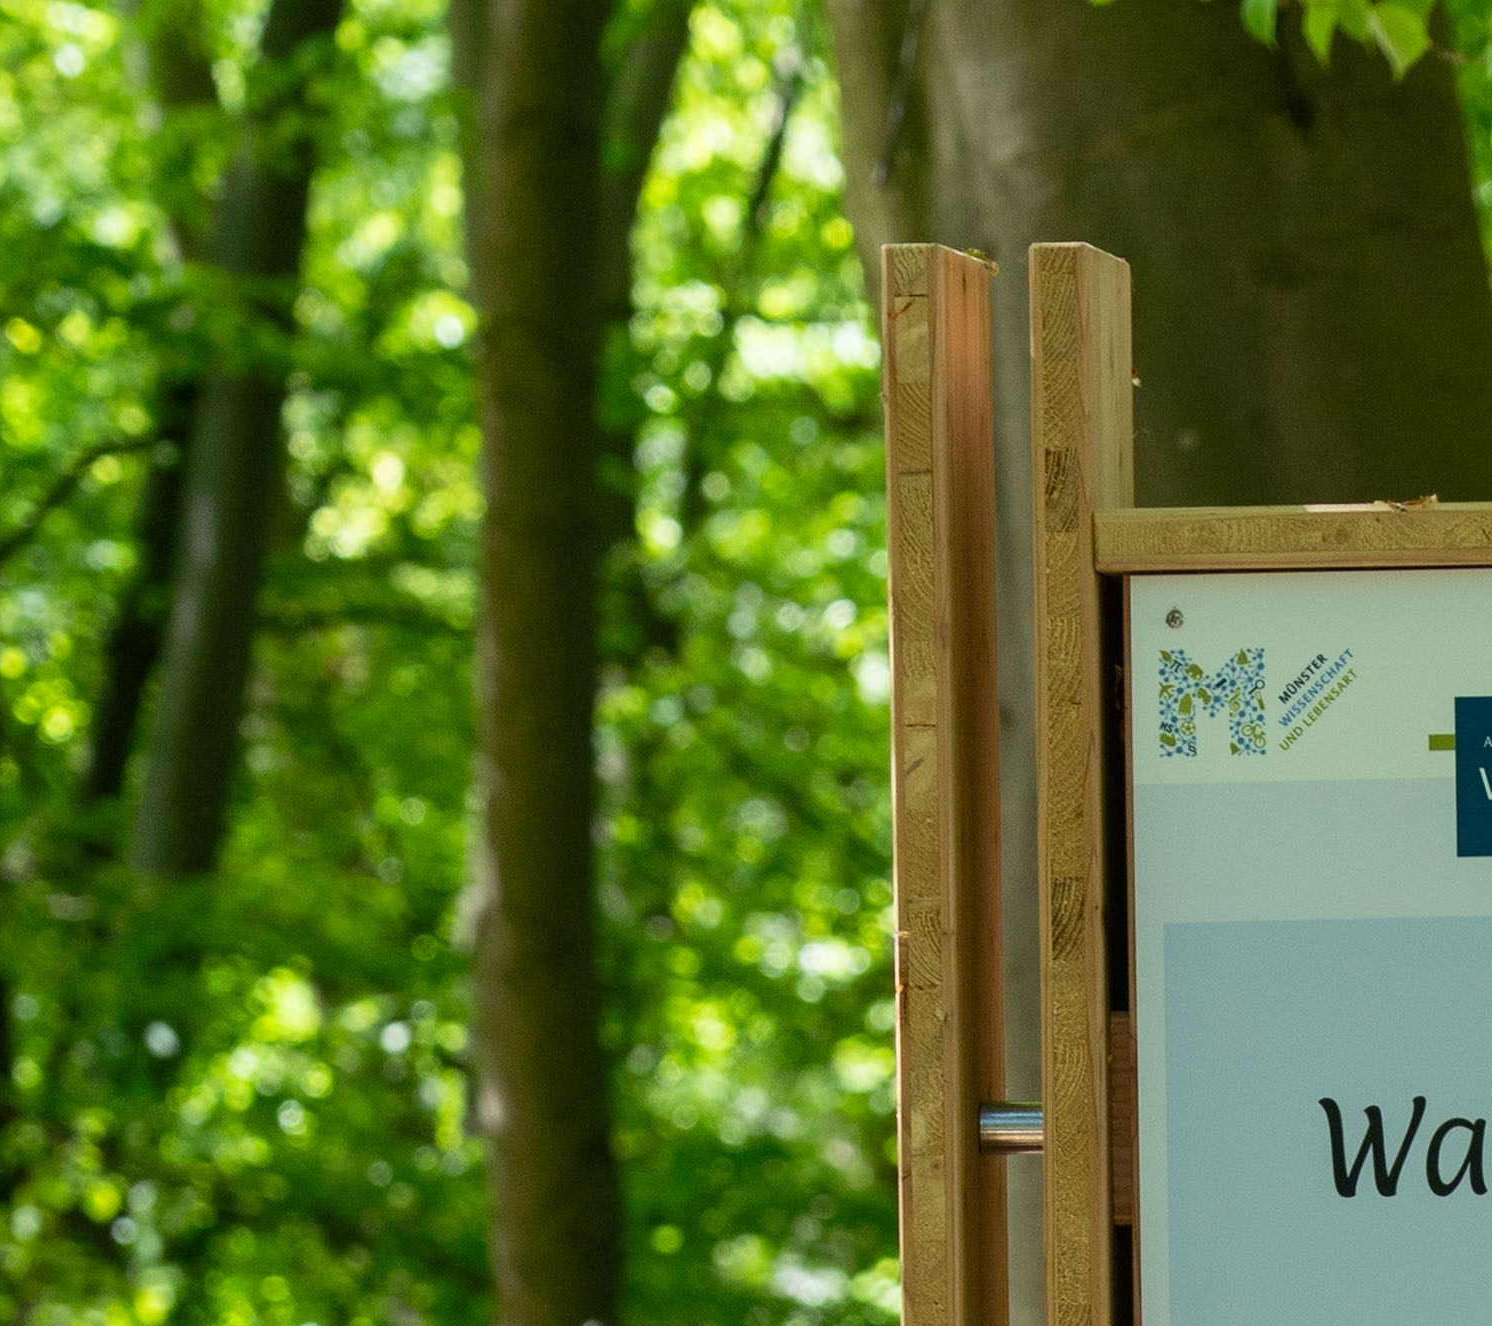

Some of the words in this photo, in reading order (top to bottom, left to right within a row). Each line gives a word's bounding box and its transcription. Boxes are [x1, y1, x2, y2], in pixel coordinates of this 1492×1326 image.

[1278, 653, 1328, 704] MÜNSTER
[1278, 648, 1355, 728] WISSENSCHAFT
[1278, 725, 1304, 751] UND
[1302, 668, 1358, 728] LEBENSART
